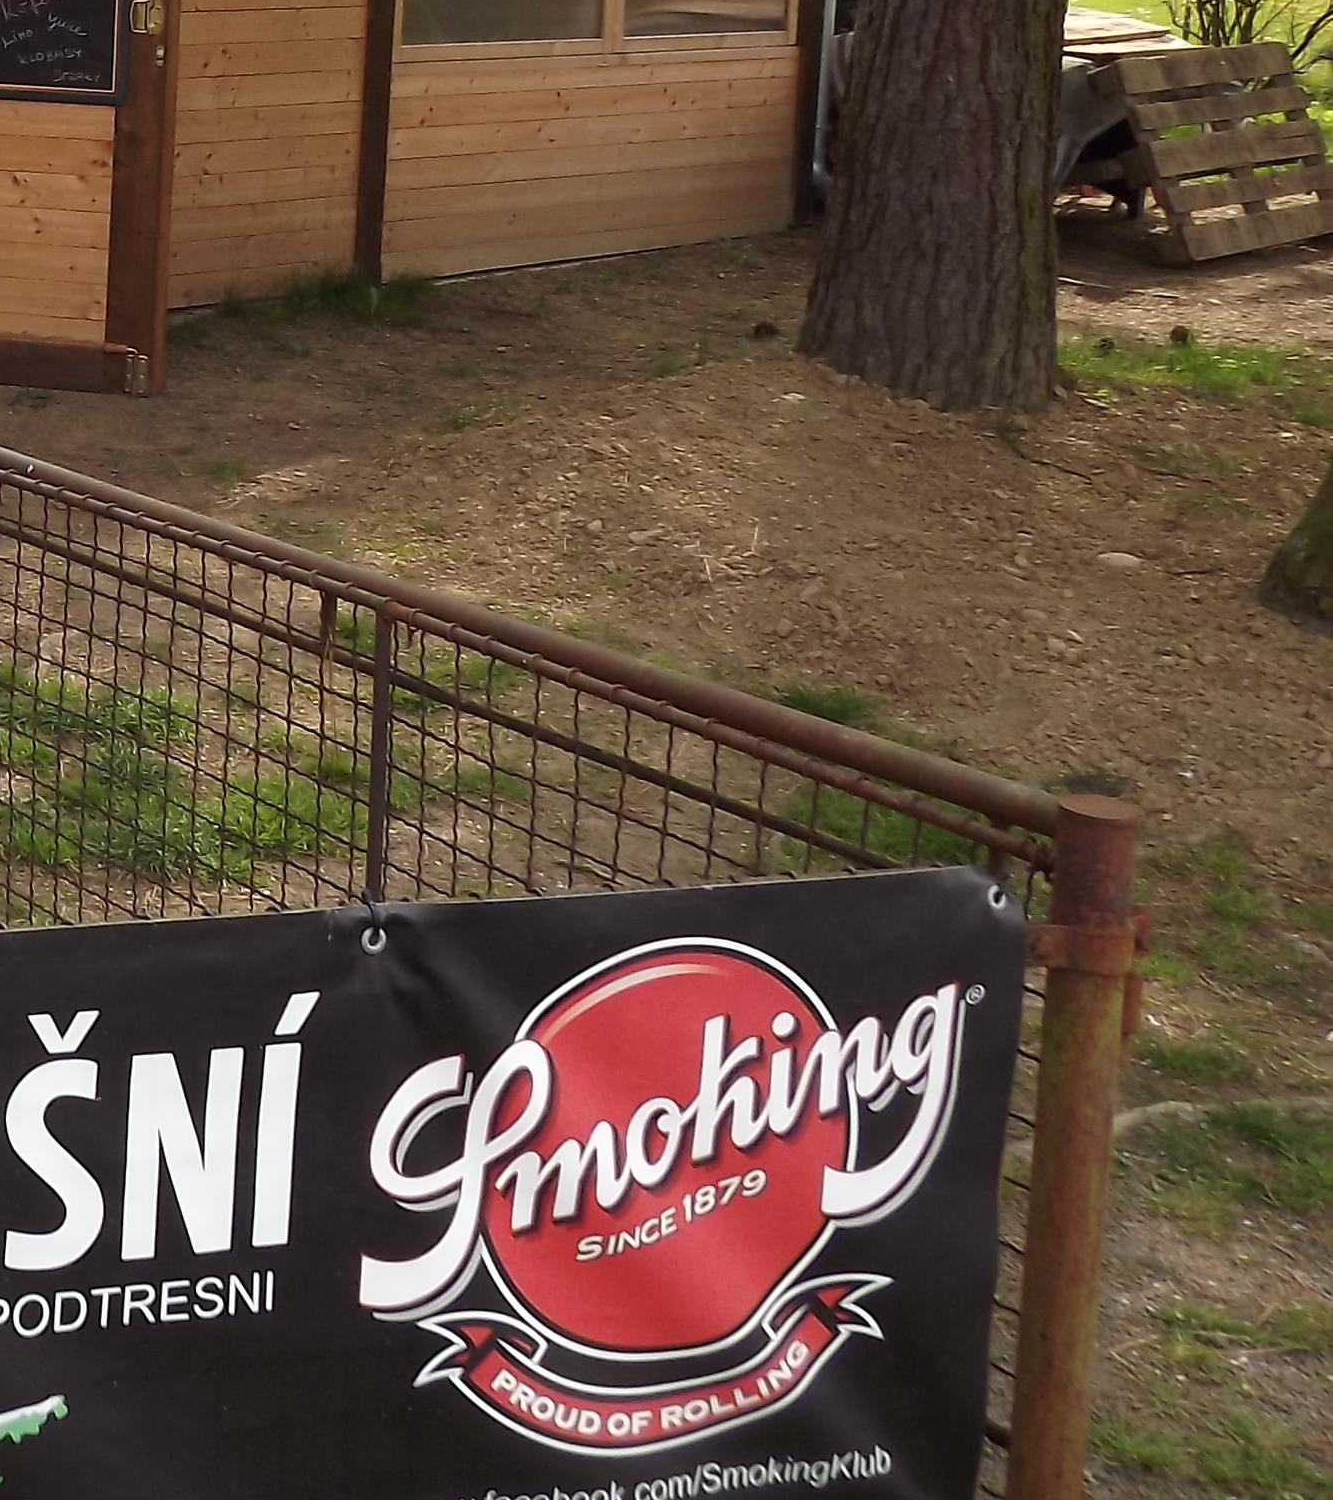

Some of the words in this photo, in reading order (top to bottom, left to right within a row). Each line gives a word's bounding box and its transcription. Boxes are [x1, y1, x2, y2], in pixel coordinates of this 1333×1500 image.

[358, 983, 962, 1316] Smoking
[575, 1207, 678, 1262] SINCE
[682, 1169, 768, 1223] 1879
[491, 1368, 602, 1436] PROUD
[606, 1409, 653, 1438] OF
[659, 1339, 811, 1432] ROLLING
